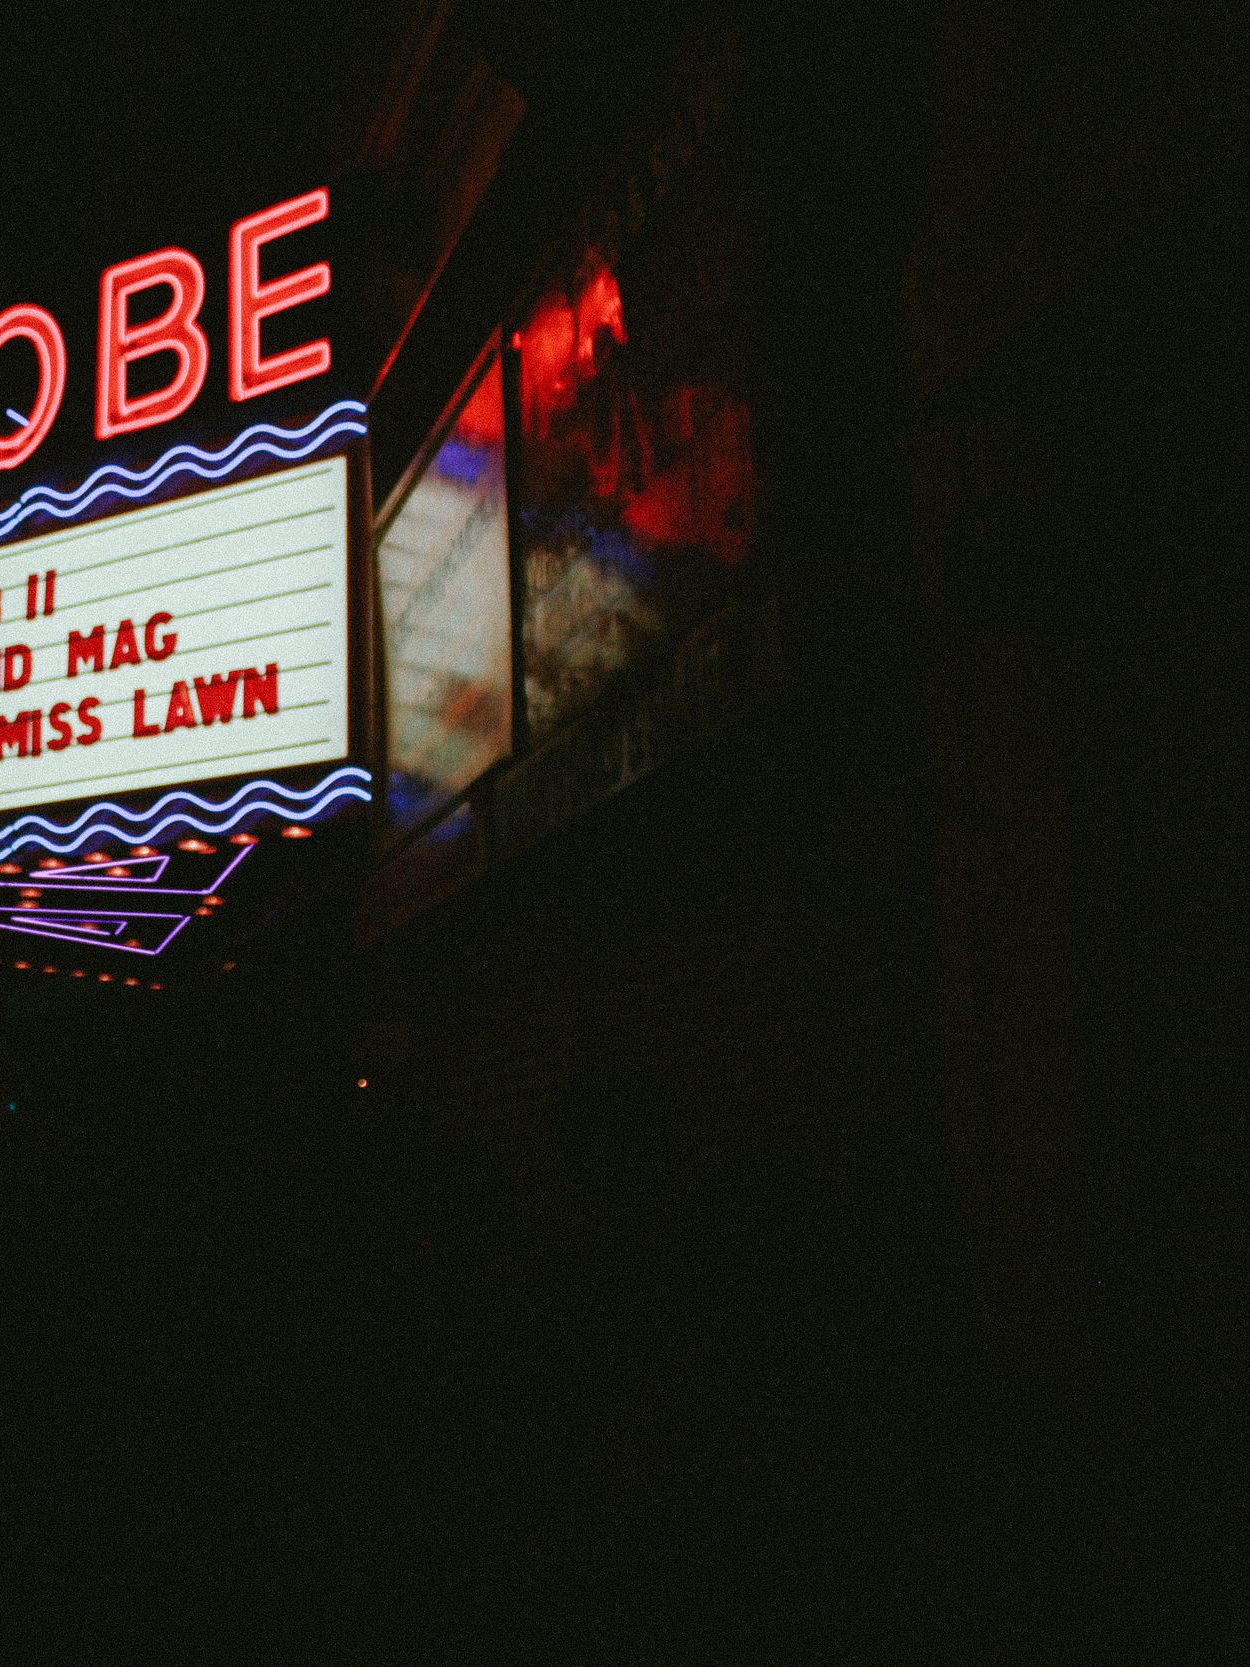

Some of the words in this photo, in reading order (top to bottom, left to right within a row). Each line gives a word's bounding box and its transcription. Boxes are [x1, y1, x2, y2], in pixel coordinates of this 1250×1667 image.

[25, 569, 57, 621] 11
[66, 611, 178, 678] MAG
[133, 661, 280, 738] LAWN
